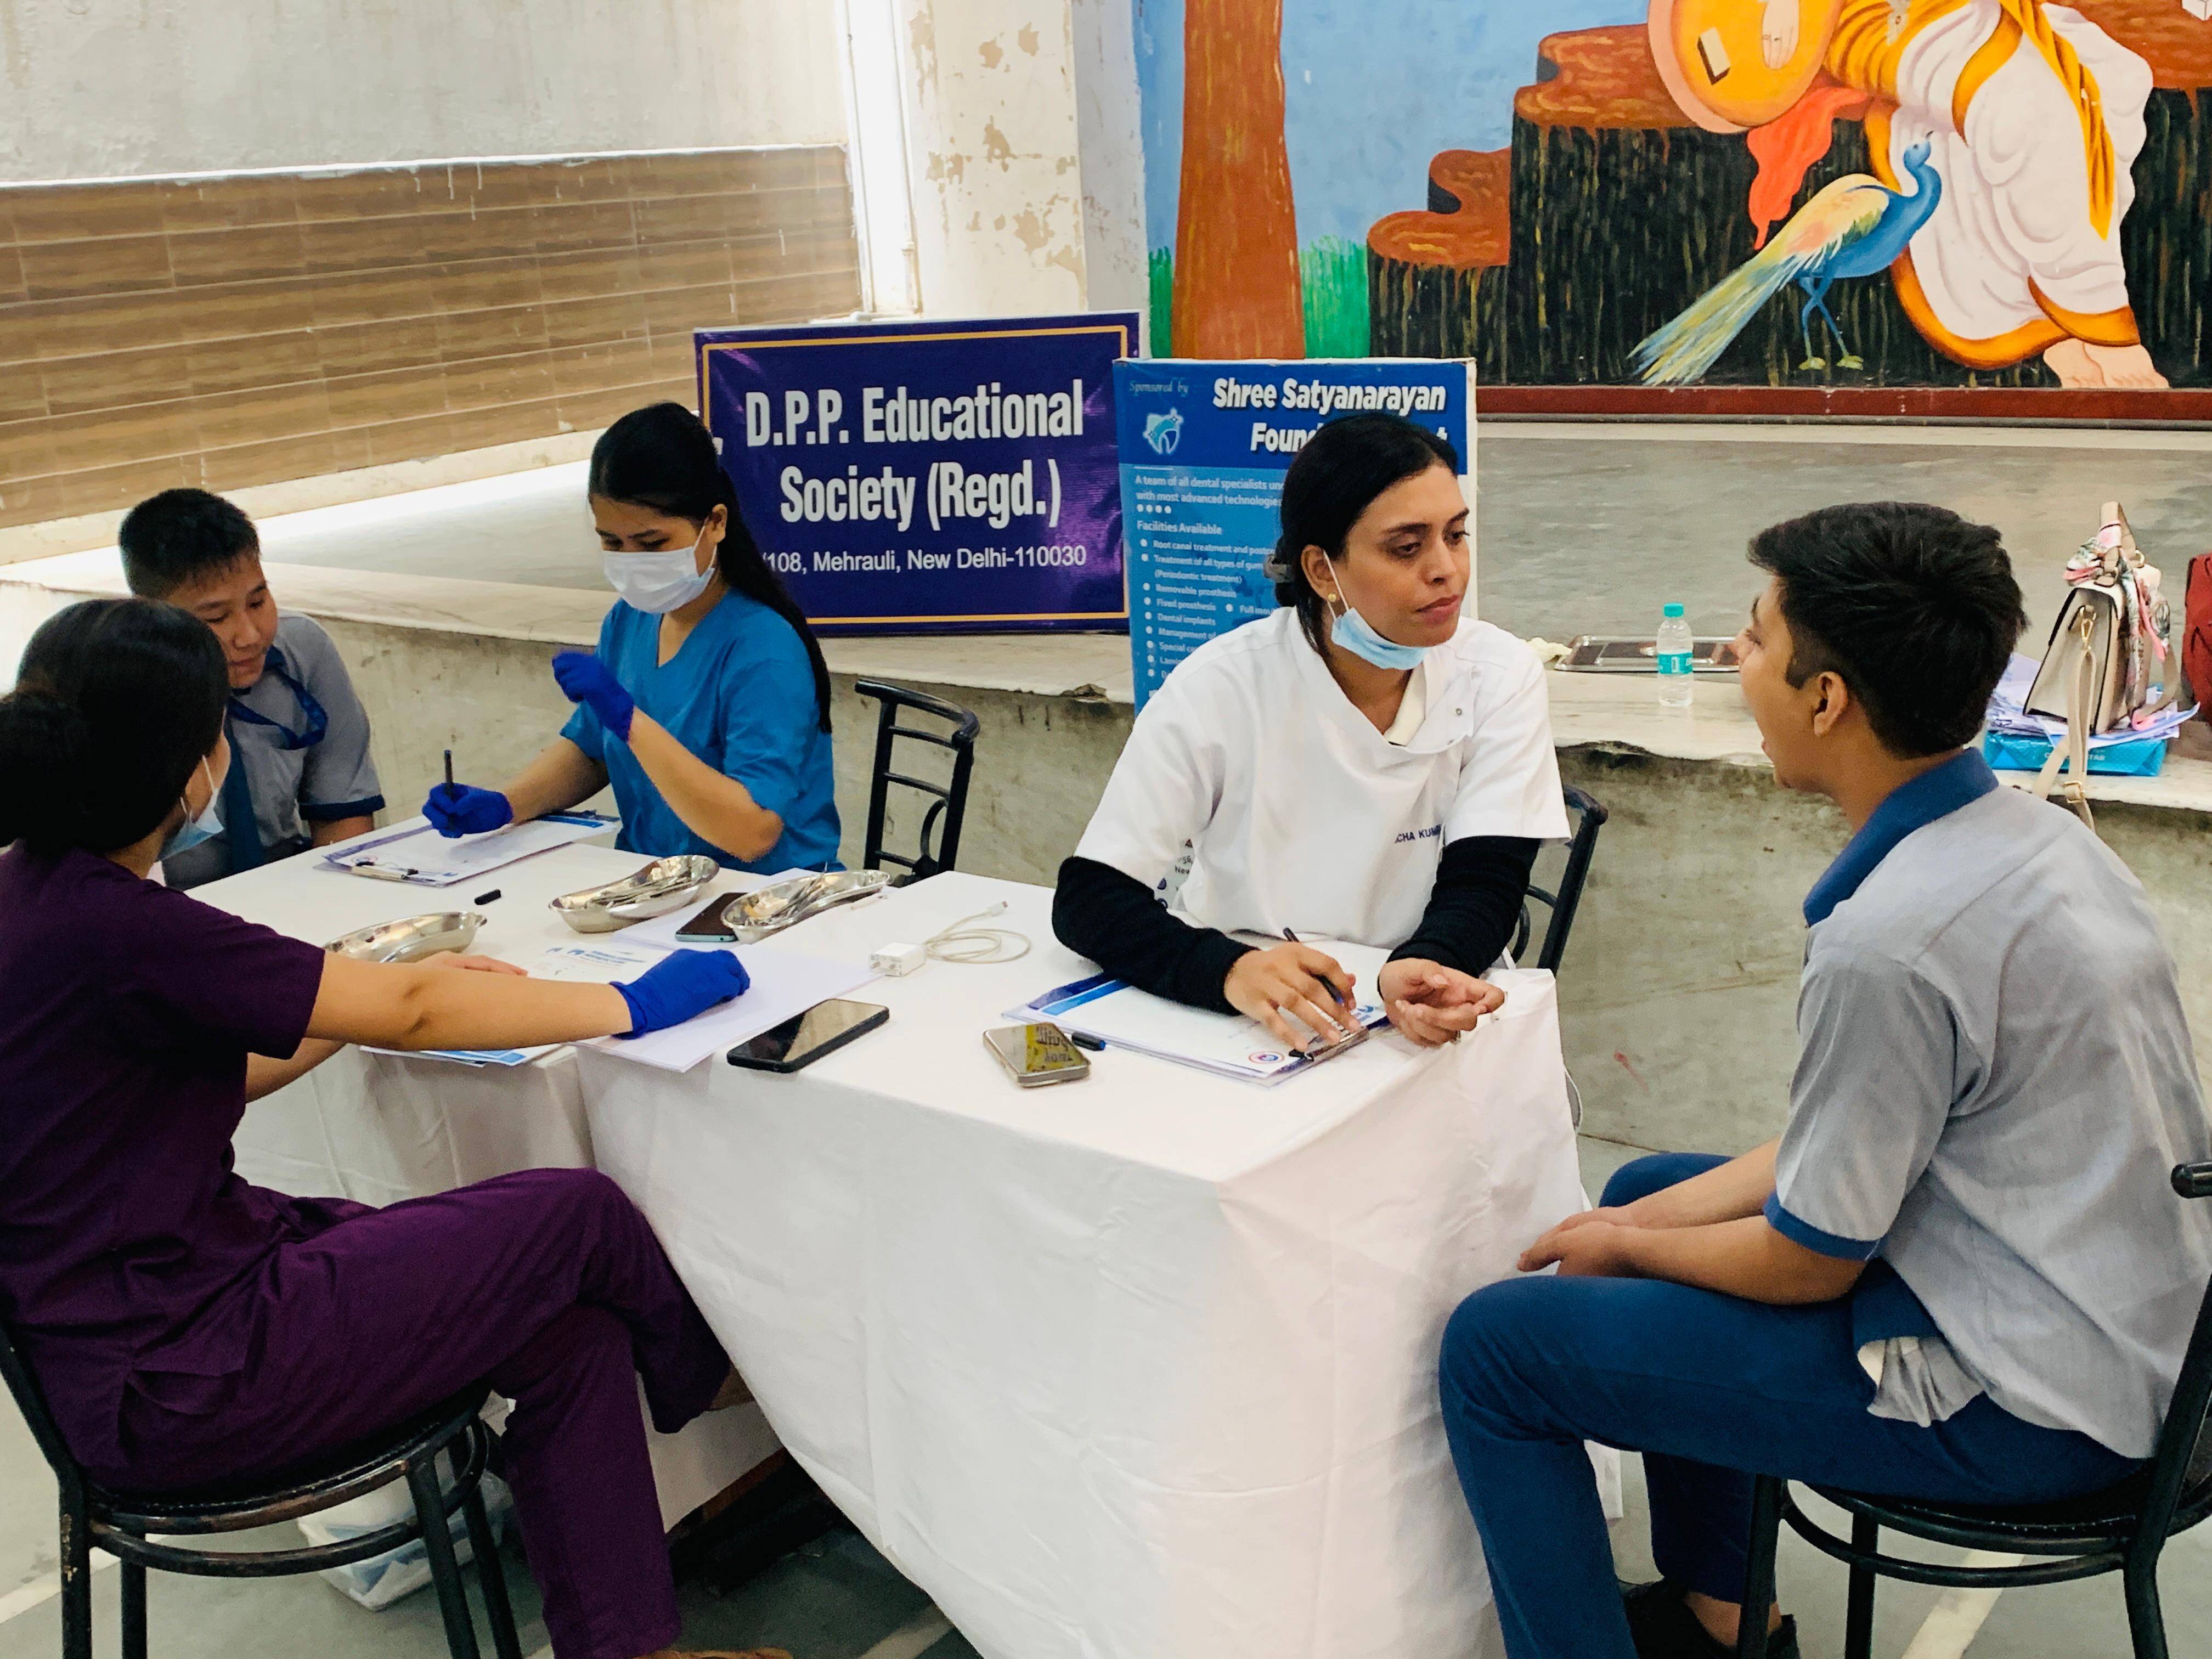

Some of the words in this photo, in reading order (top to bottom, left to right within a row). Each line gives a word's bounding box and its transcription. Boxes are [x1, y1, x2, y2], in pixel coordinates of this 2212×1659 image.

[1130, 377, 1175, 397] Sponsored
[1177, 377, 1189, 397] by
[1212, 377, 1277, 408] Shree
[1281, 378, 1447, 417] Satyanarayan
[746, 388, 849, 447] D.P.P.
[862, 379, 1083, 443] Educational
[1135, 475, 1142, 484] A
[1143, 476, 1166, 486] team
[1167, 476, 1177, 486] of
[1178, 476, 1189, 487] all
[1190, 477, 1220, 488] dental
[1221, 478, 1267, 491] specialists
[780, 465, 916, 532] Society
[928, 459, 1061, 531] (Regd.)
[1136, 490, 1155, 501] with
[1156, 493, 1180, 501] most
[1181, 494, 1223, 504] advanced
[1137, 520, 1178, 533] Facilities
[1180, 522, 1222, 535] Available
[1153, 539, 1171, 549] Root
[1172, 541, 1192, 550] canal
[1193, 543, 1232, 553] treatment
[1233, 545, 1248, 554] and
[814, 550, 901, 573] Mehrauli,
[907, 549, 951, 569] New
[957, 545, 1086, 568] Delhi-110030
[1154, 554, 1193, 565] Treatment
[1194, 556, 1203, 566] of
[1204, 557, 1212, 566] all
[1213, 558, 1235, 569] types
[1236, 560, 1245, 568] of
[1155, 583, 1198, 595] Removable
[1156, 598, 1177, 608] Fixed
[1178, 601, 1217, 611] prosthesis
[1158, 612, 1182, 623] Dental
[1183, 616, 1216, 626] implants
[1158, 627, 1207, 640] Management
[1159, 641, 1186, 652] Special
